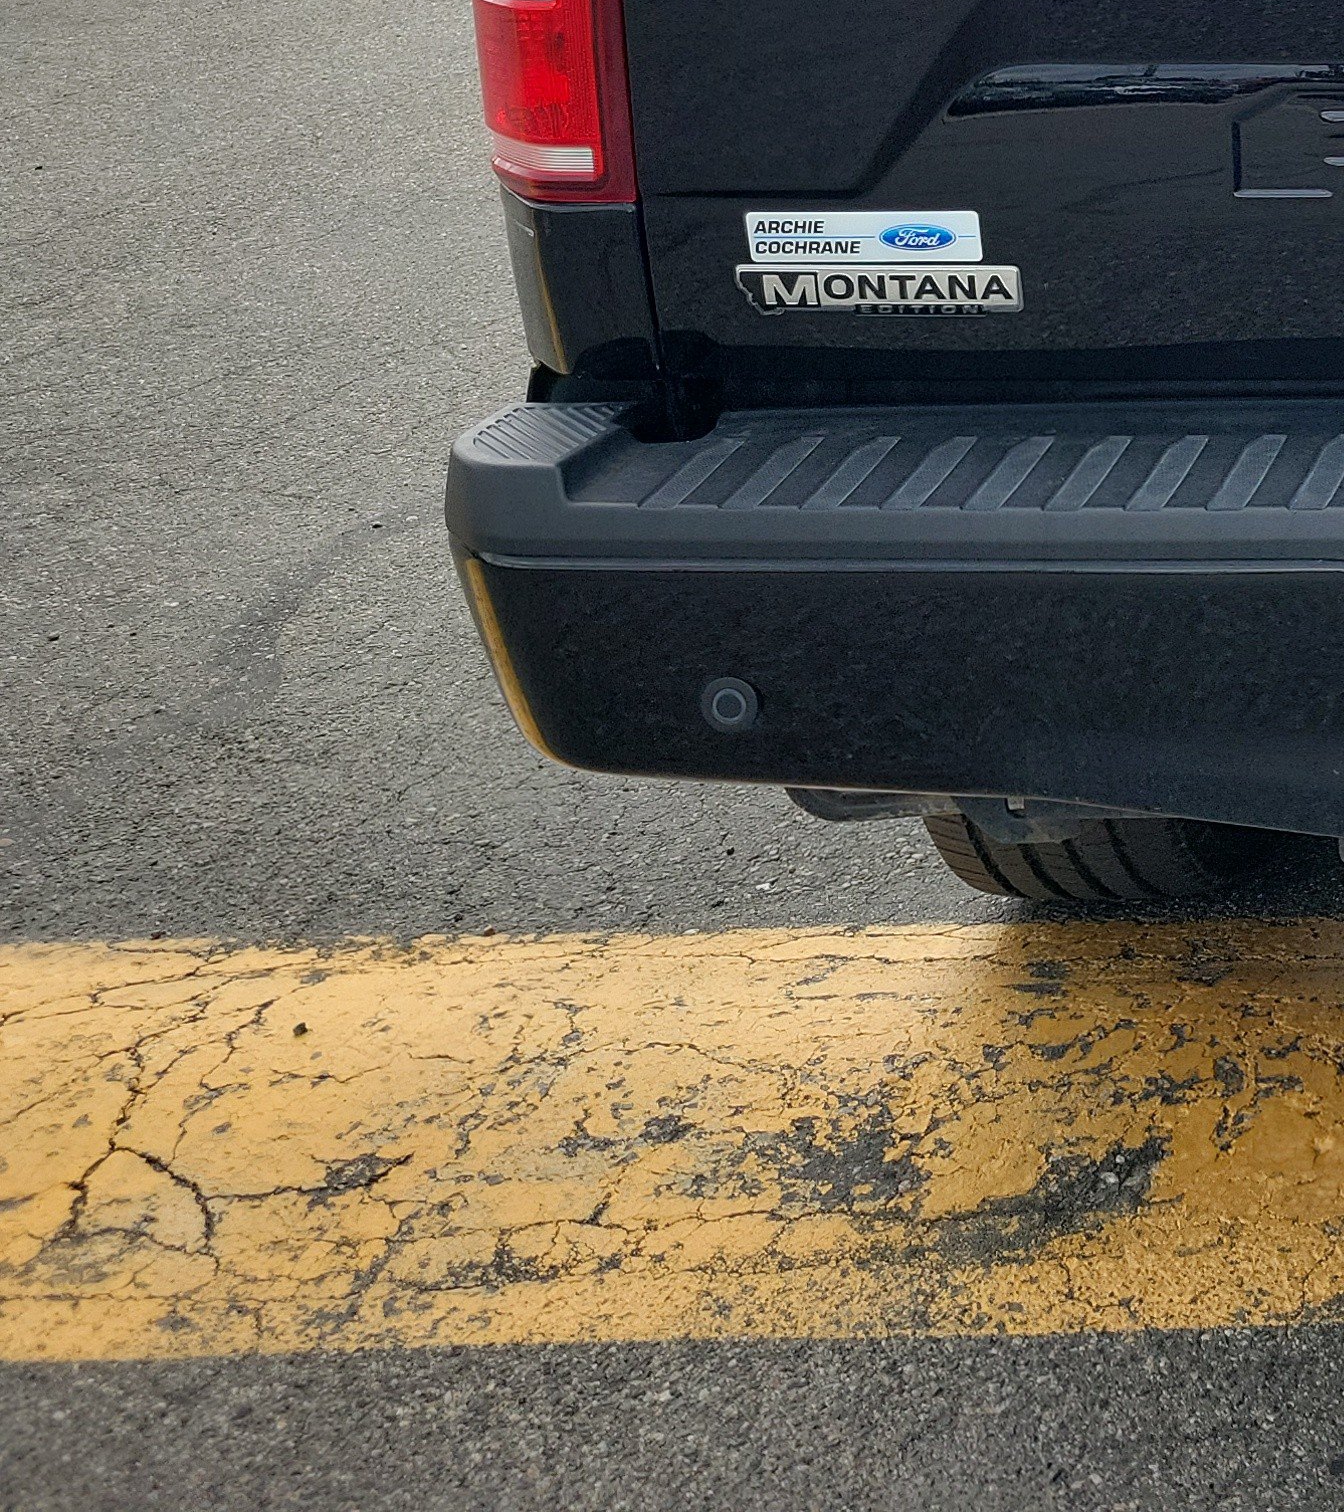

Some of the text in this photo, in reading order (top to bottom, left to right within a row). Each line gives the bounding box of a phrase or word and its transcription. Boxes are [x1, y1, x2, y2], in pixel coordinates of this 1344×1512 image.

[753, 220, 825, 234] ARCHIE
[894, 228, 941, 247] Ford
[755, 240, 861, 255] COCHRANE
[761, 273, 1014, 306] MONTANA
